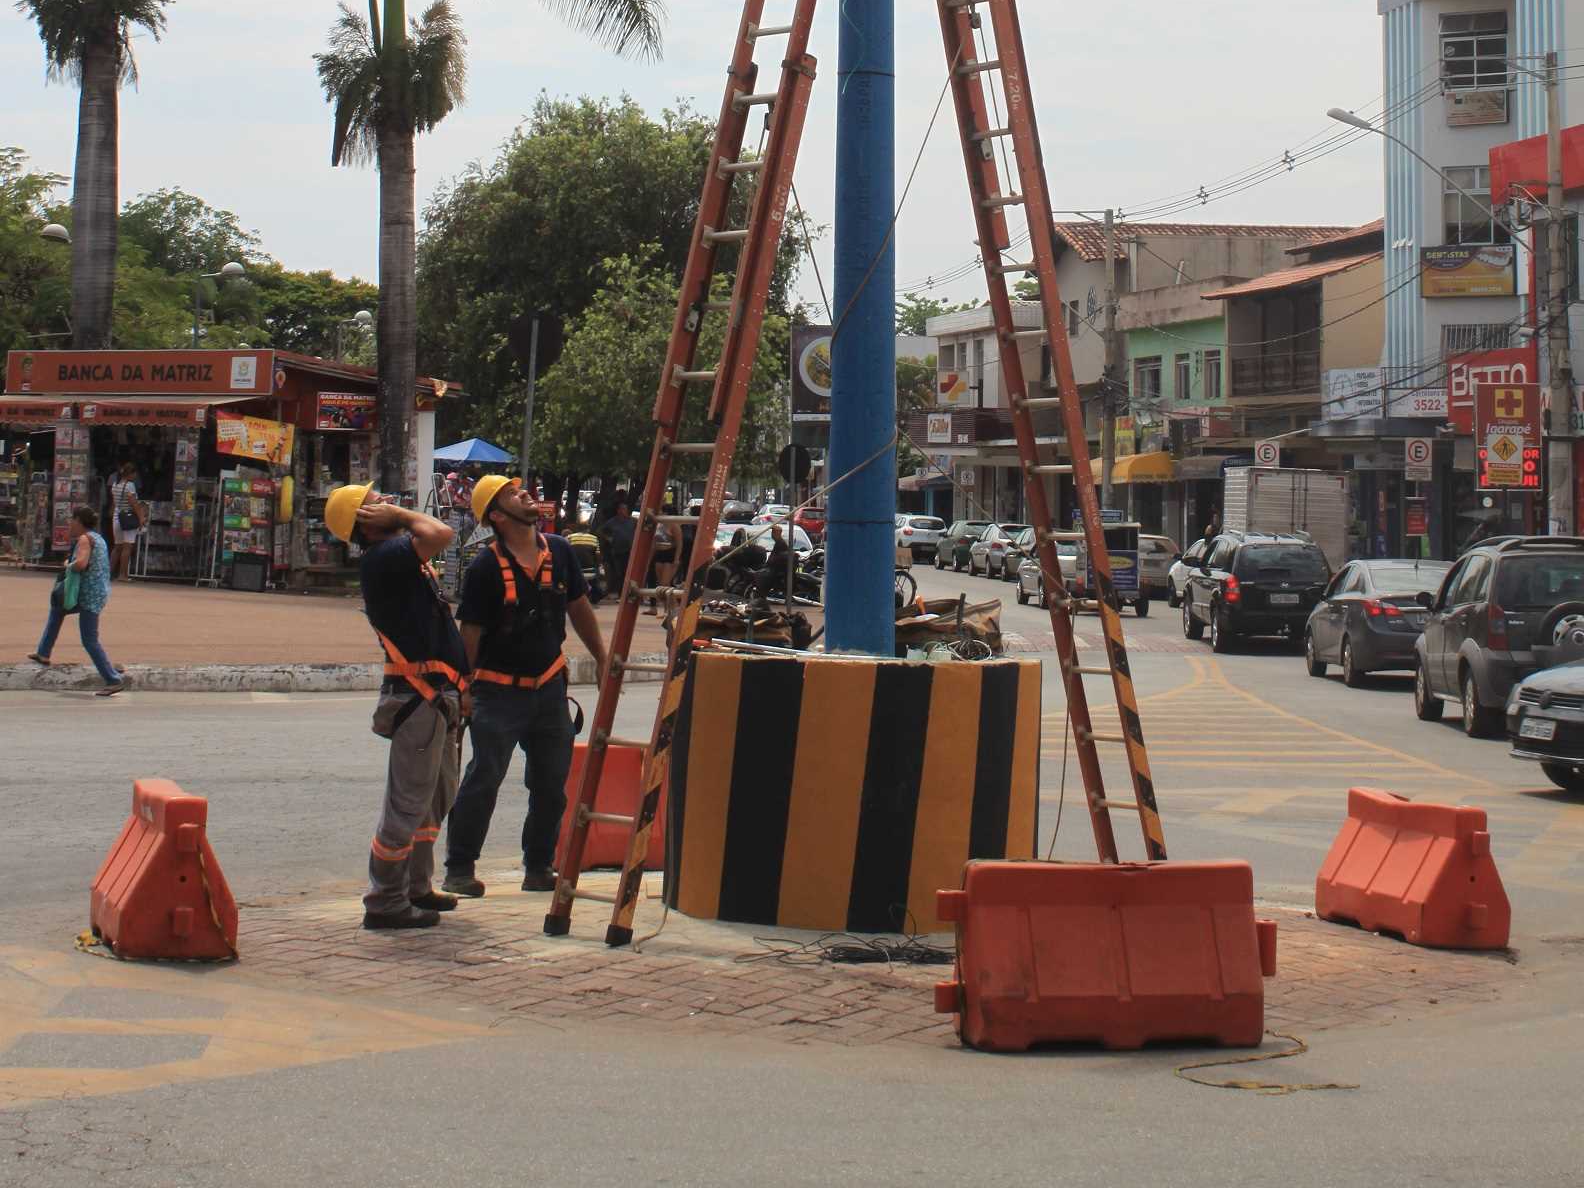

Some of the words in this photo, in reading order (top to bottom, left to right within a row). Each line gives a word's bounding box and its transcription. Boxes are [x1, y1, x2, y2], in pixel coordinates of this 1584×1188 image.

[58, 364, 113, 381] BANCA
[121, 364, 144, 381] DA
[151, 363, 214, 381] MATRIZ
[1414, 399, 1447, 411] 3522-
[1486, 423, 1532, 436] Igarapé
[1263, 447, 1271, 459] E
[1414, 445, 1423, 459] E
